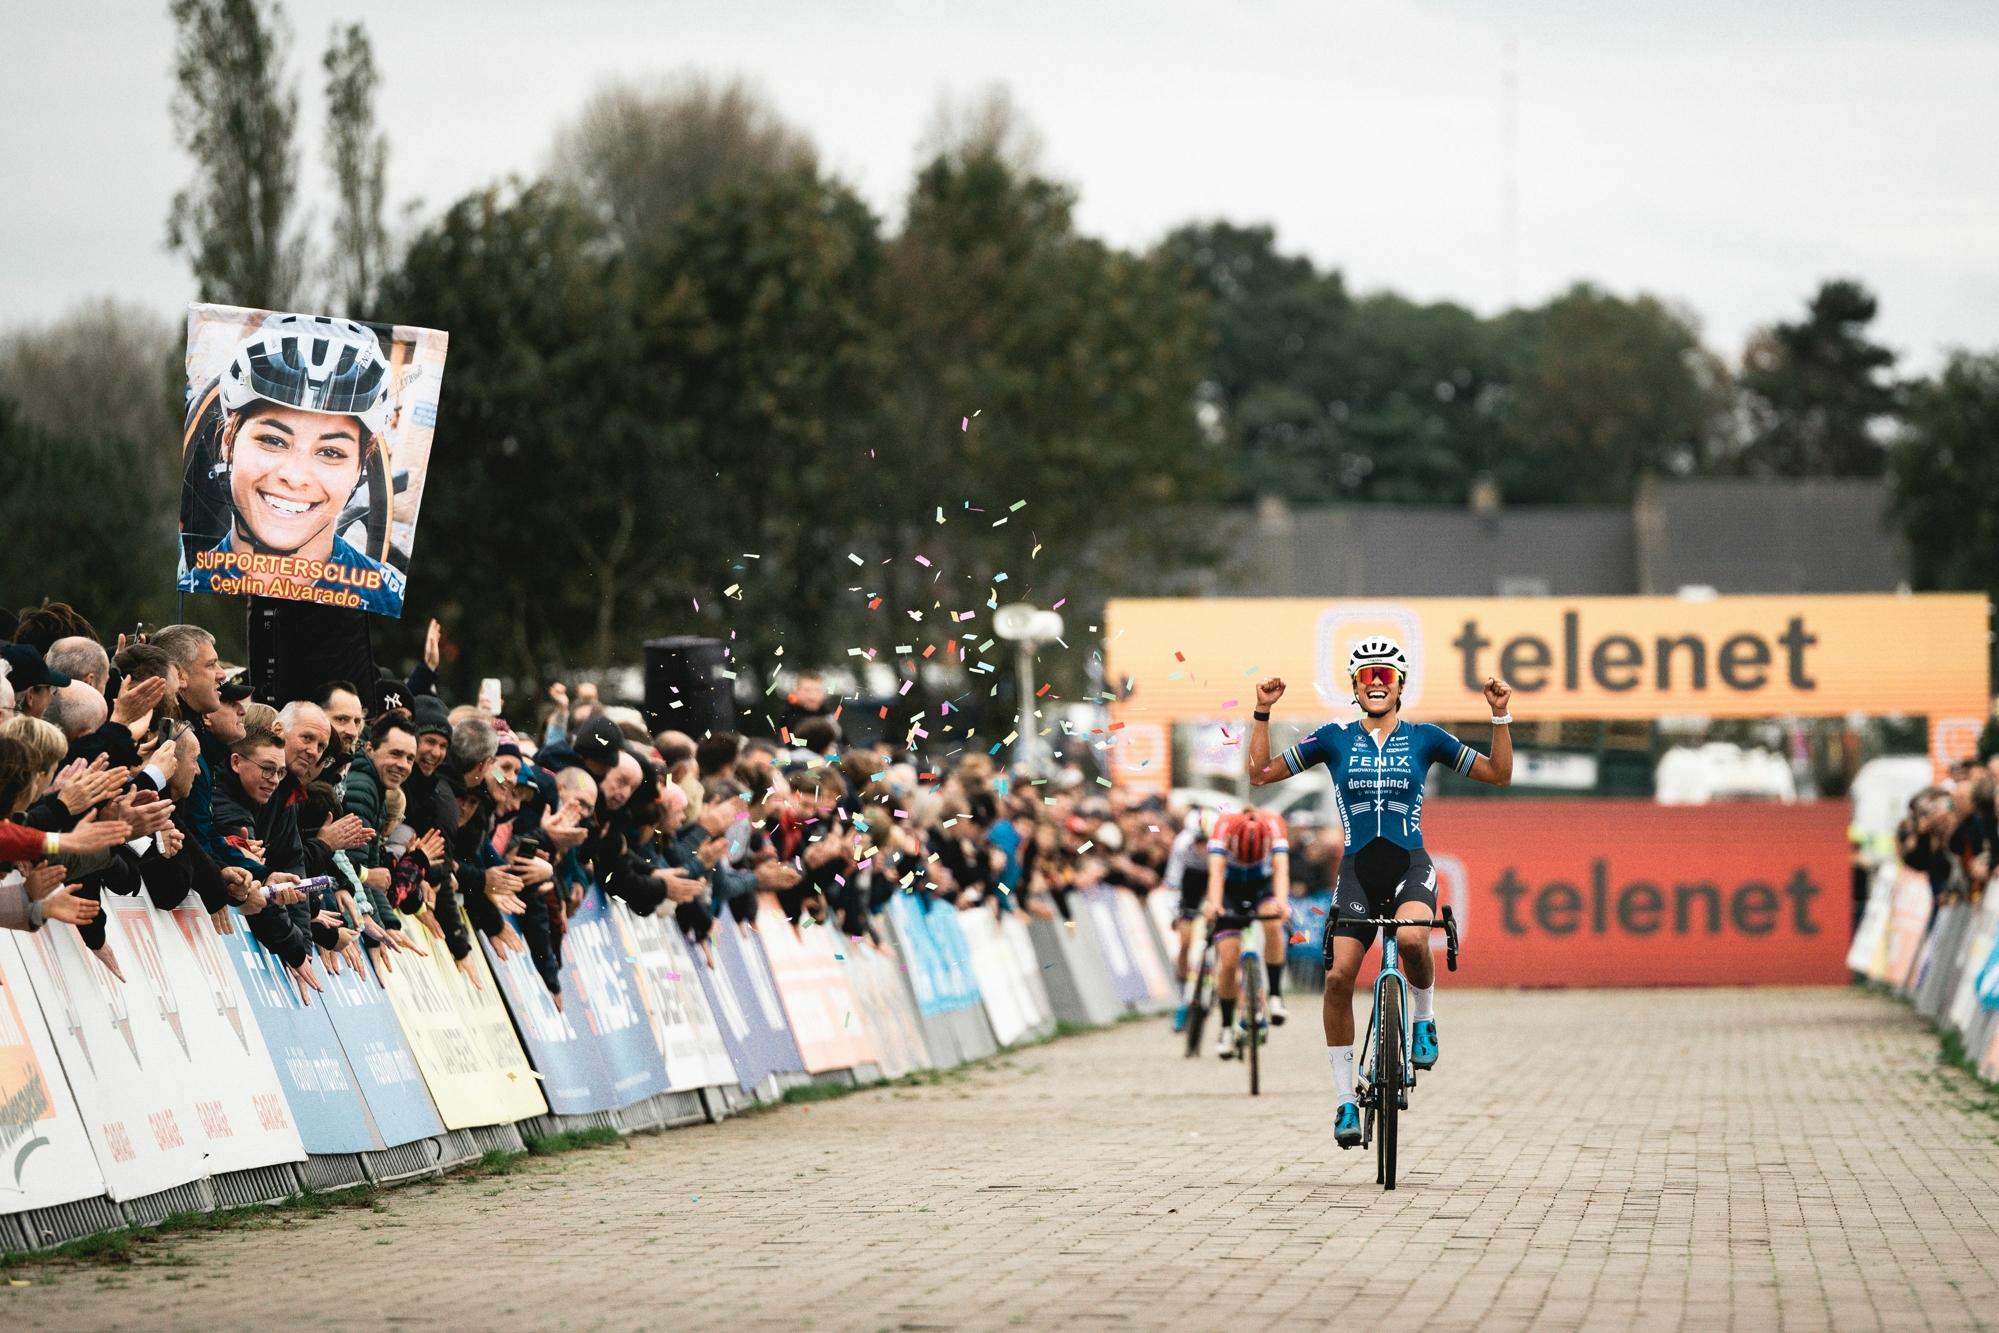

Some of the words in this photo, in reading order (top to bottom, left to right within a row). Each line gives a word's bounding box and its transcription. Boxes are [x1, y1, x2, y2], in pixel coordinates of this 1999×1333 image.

[196, 551, 382, 589] SUPPORTERSCLUB
[210, 574, 265, 596] Ceylin
[269, 579, 362, 608] Alvarado
[1454, 611, 1818, 692] telenet
[384, 692, 403, 711] NY
[1349, 755, 1410, 767] FENIX
[1348, 777, 1410, 790] deceuninck
[1494, 860, 1820, 937] telenet
